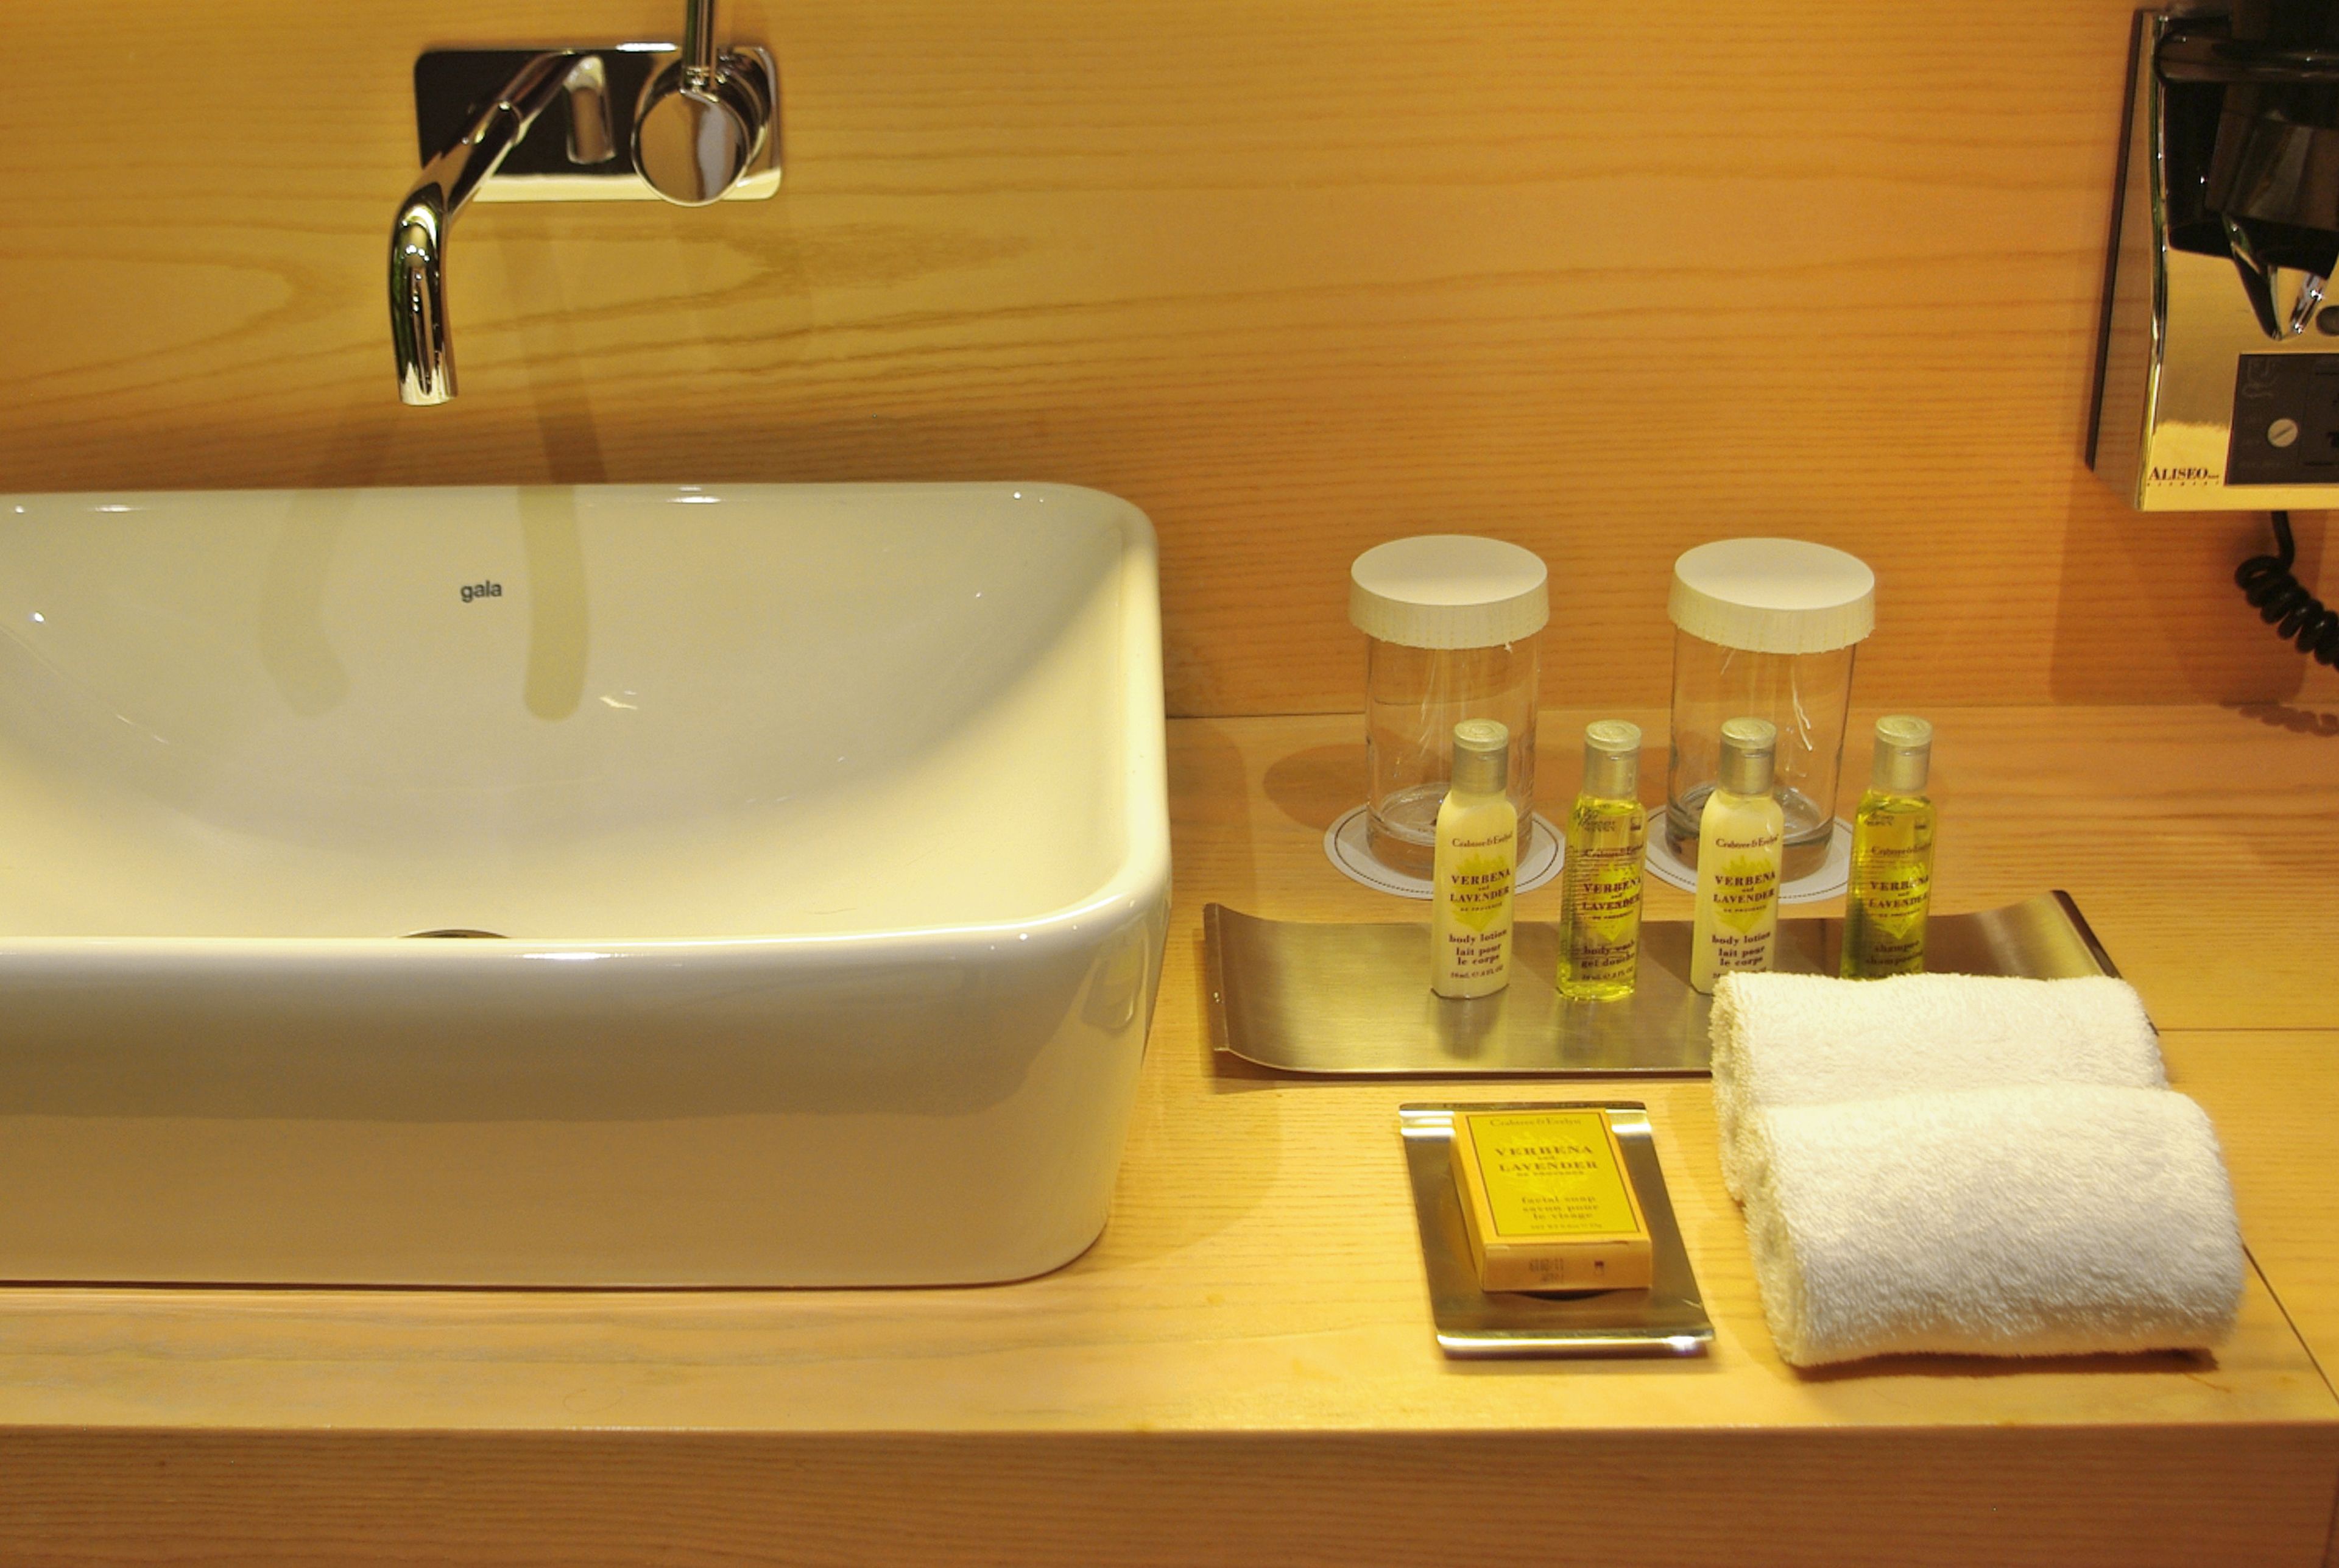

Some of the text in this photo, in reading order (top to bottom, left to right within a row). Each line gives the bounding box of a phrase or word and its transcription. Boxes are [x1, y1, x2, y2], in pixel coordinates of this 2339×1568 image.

[2149, 467, 2209, 481] ALISEO
[460, 580, 502, 603] gala
[1451, 868, 1511, 885] VERBENA
[1715, 871, 1776, 886] VERBENA
[1869, 875, 1929, 891] VERBNA
[1450, 886, 1509, 903] LAVENDER
[1713, 888, 1775, 904] LAVENDER
[1448, 933, 1475, 945] body
[1712, 934, 1739, 946] body
[1718, 947, 1738, 957] lait
[1458, 956, 1467, 966] le
[1720, 958, 1730, 966] le
[1494, 1146, 1595, 1156] VERBENA
[1498, 1160, 1598, 1173] LAVENDER
[1522, 1196, 1559, 1204] facial
